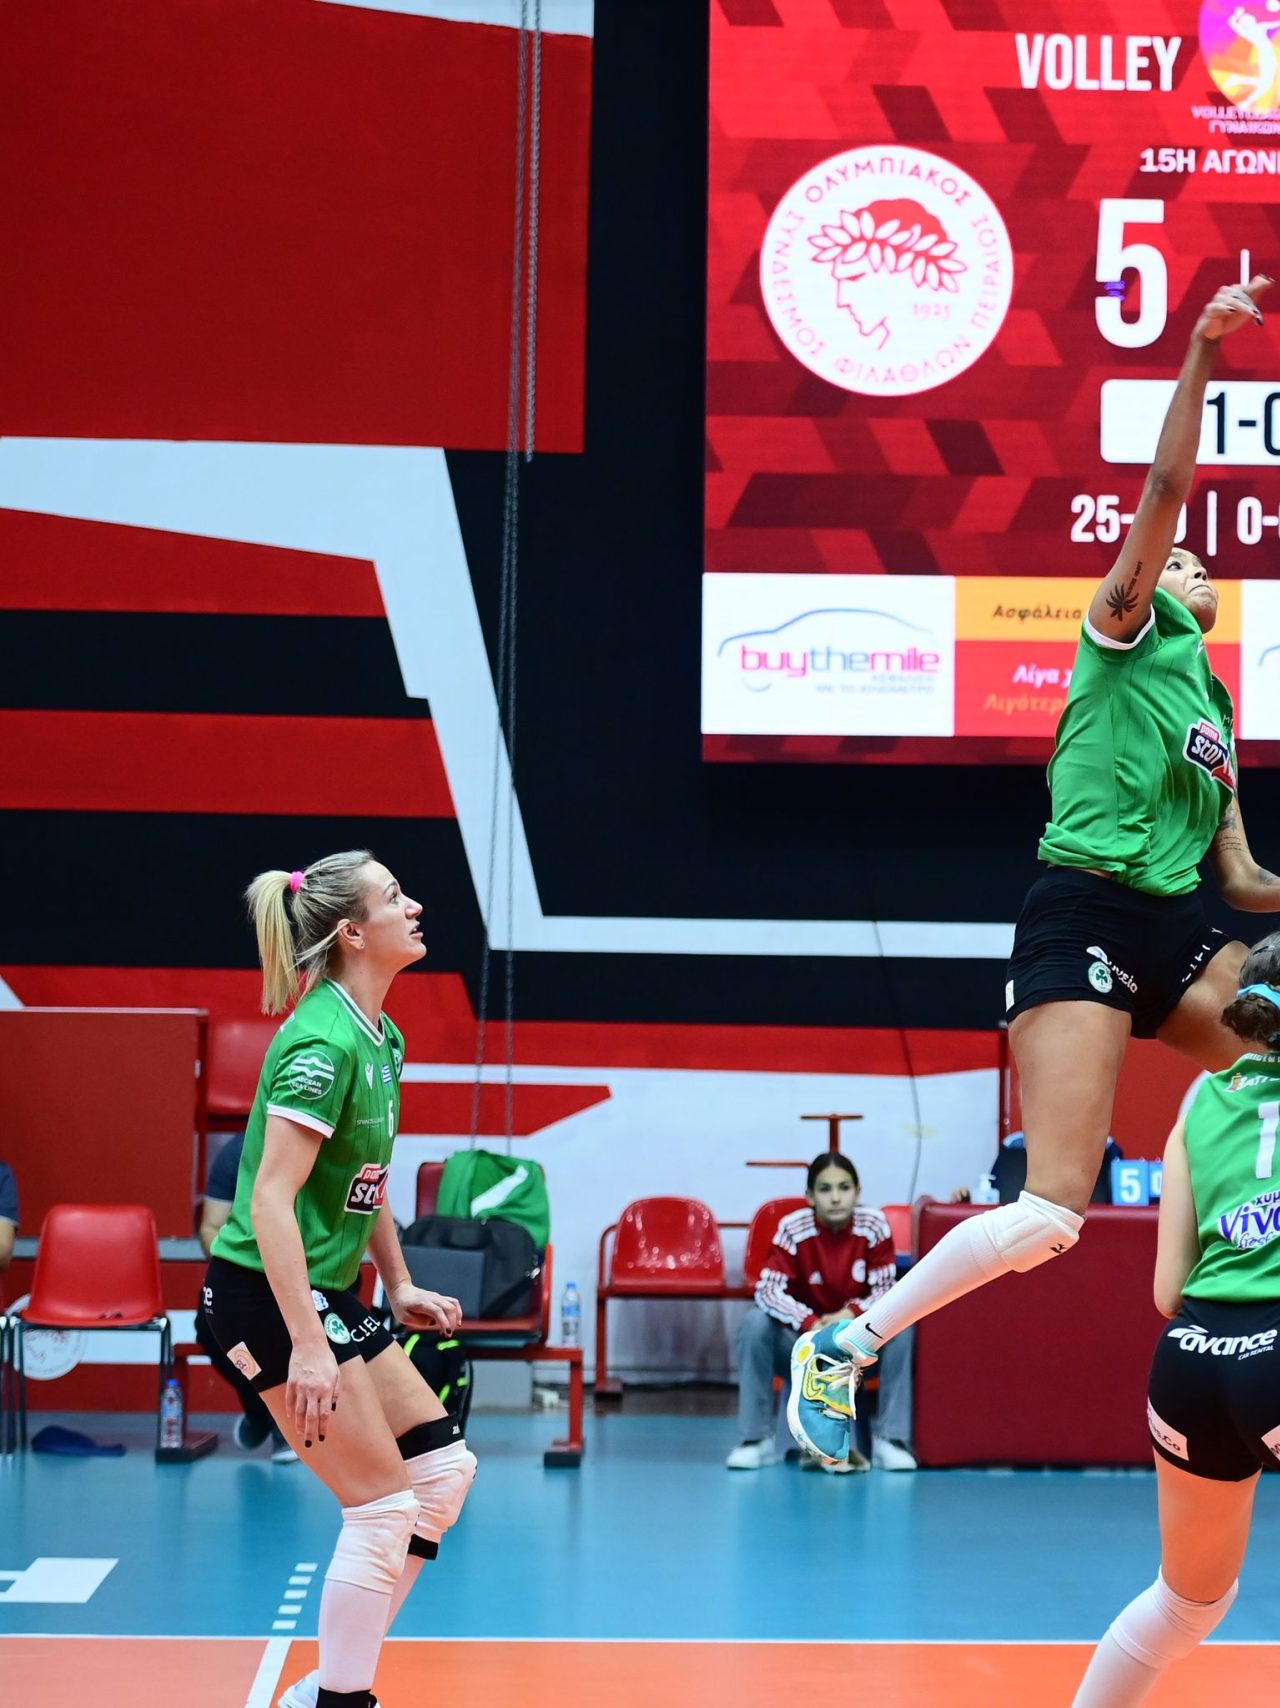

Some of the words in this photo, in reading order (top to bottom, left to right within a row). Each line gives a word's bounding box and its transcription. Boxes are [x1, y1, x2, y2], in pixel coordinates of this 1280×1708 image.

[1015, 33, 1182, 91] VOLLEY
[1095, 198, 1168, 349] 5
[741, 645, 940, 678] buythemile
[1255, 1100, 1280, 1180] 1
[1119, 1168, 1142, 1204] 5
[350, 1315, 381, 1343] CIEL
[1179, 1329, 1279, 1357] avance
